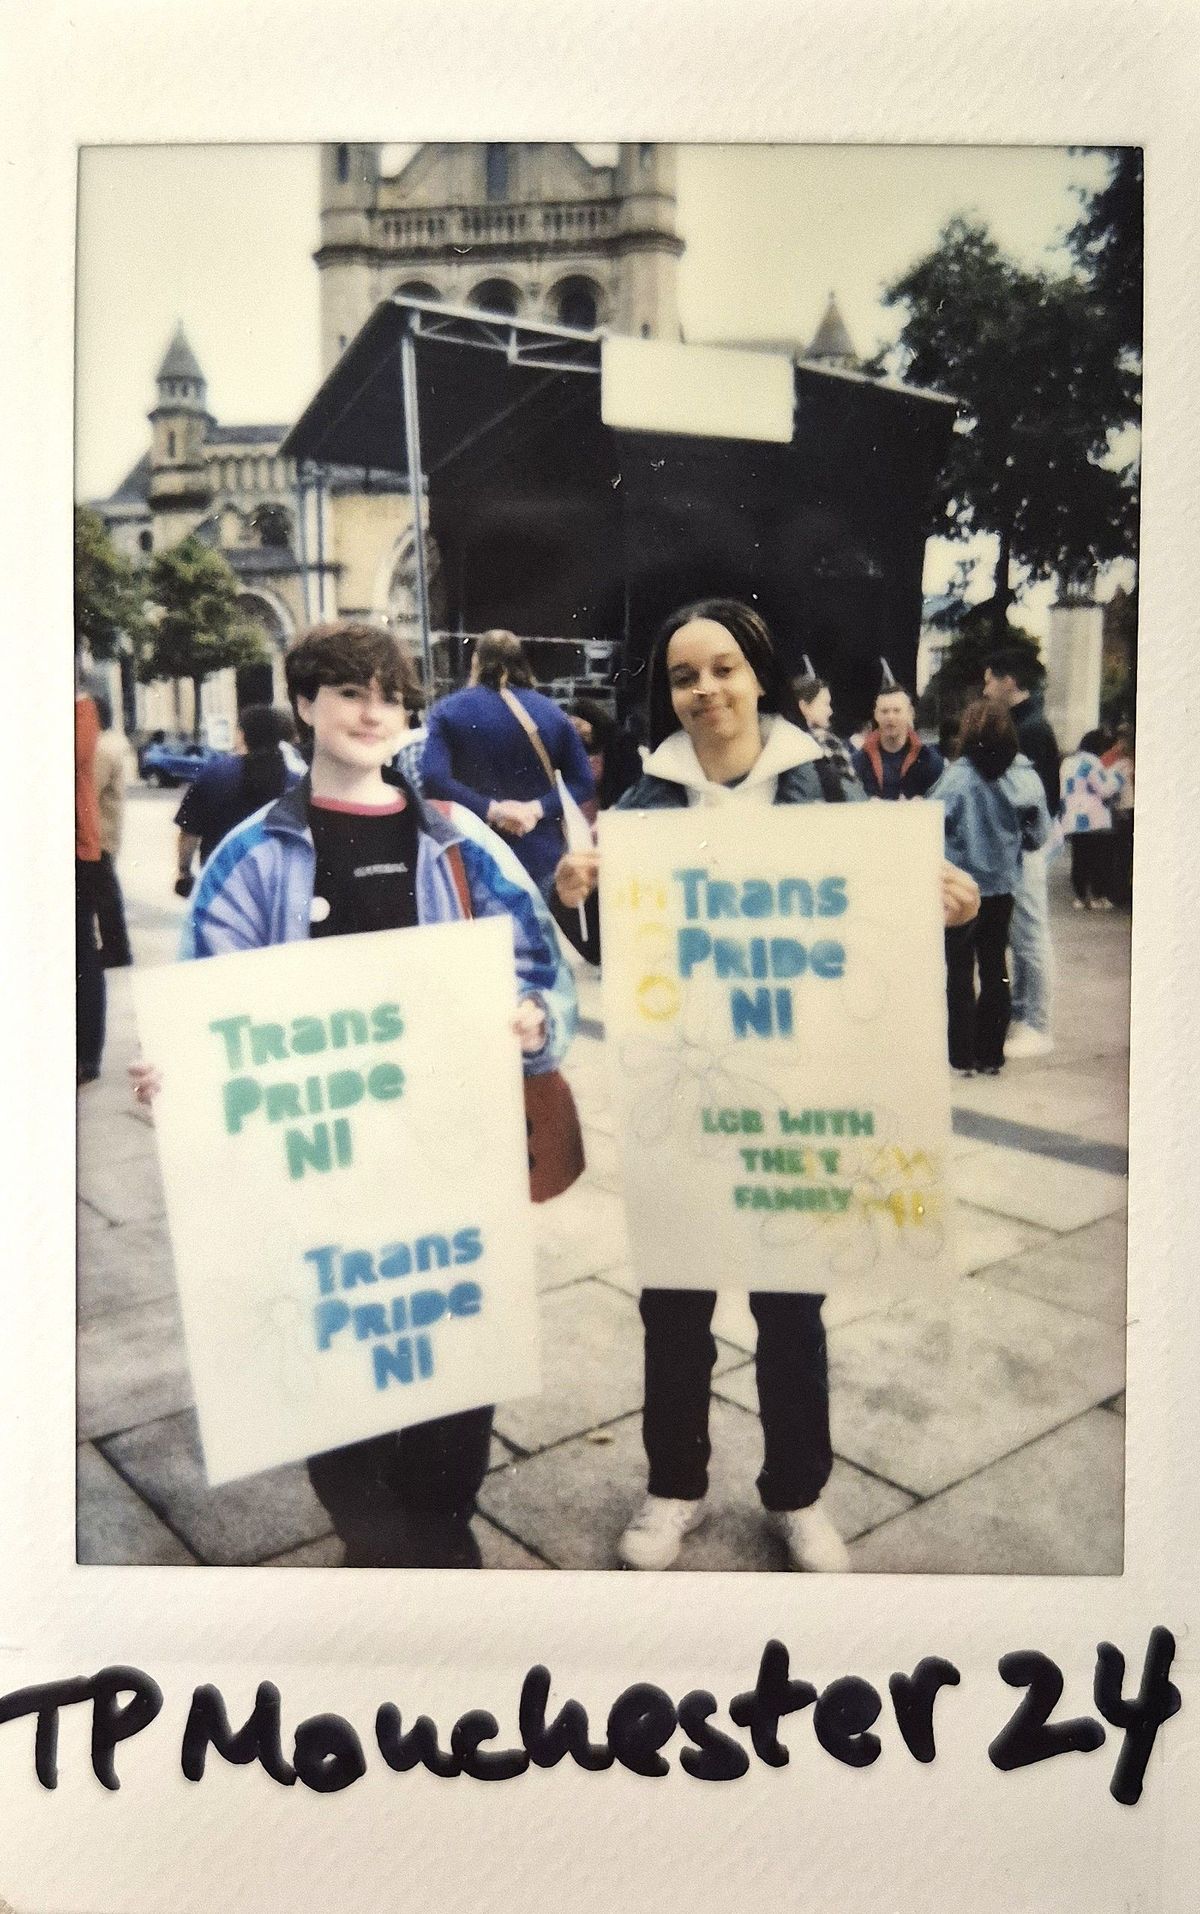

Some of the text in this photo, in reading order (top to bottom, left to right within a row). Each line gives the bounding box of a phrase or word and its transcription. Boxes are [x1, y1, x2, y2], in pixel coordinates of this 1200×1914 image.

[730, 987, 794, 1038] NI
[285, 1117, 354, 1181] NI
[779, 1108, 874, 1136] WITH
[739, 1147, 806, 1174] THE
[372, 1334, 435, 1391] NI
[0, 1666, 163, 1791] TP
[988, 1626, 1182, 1807] 24
